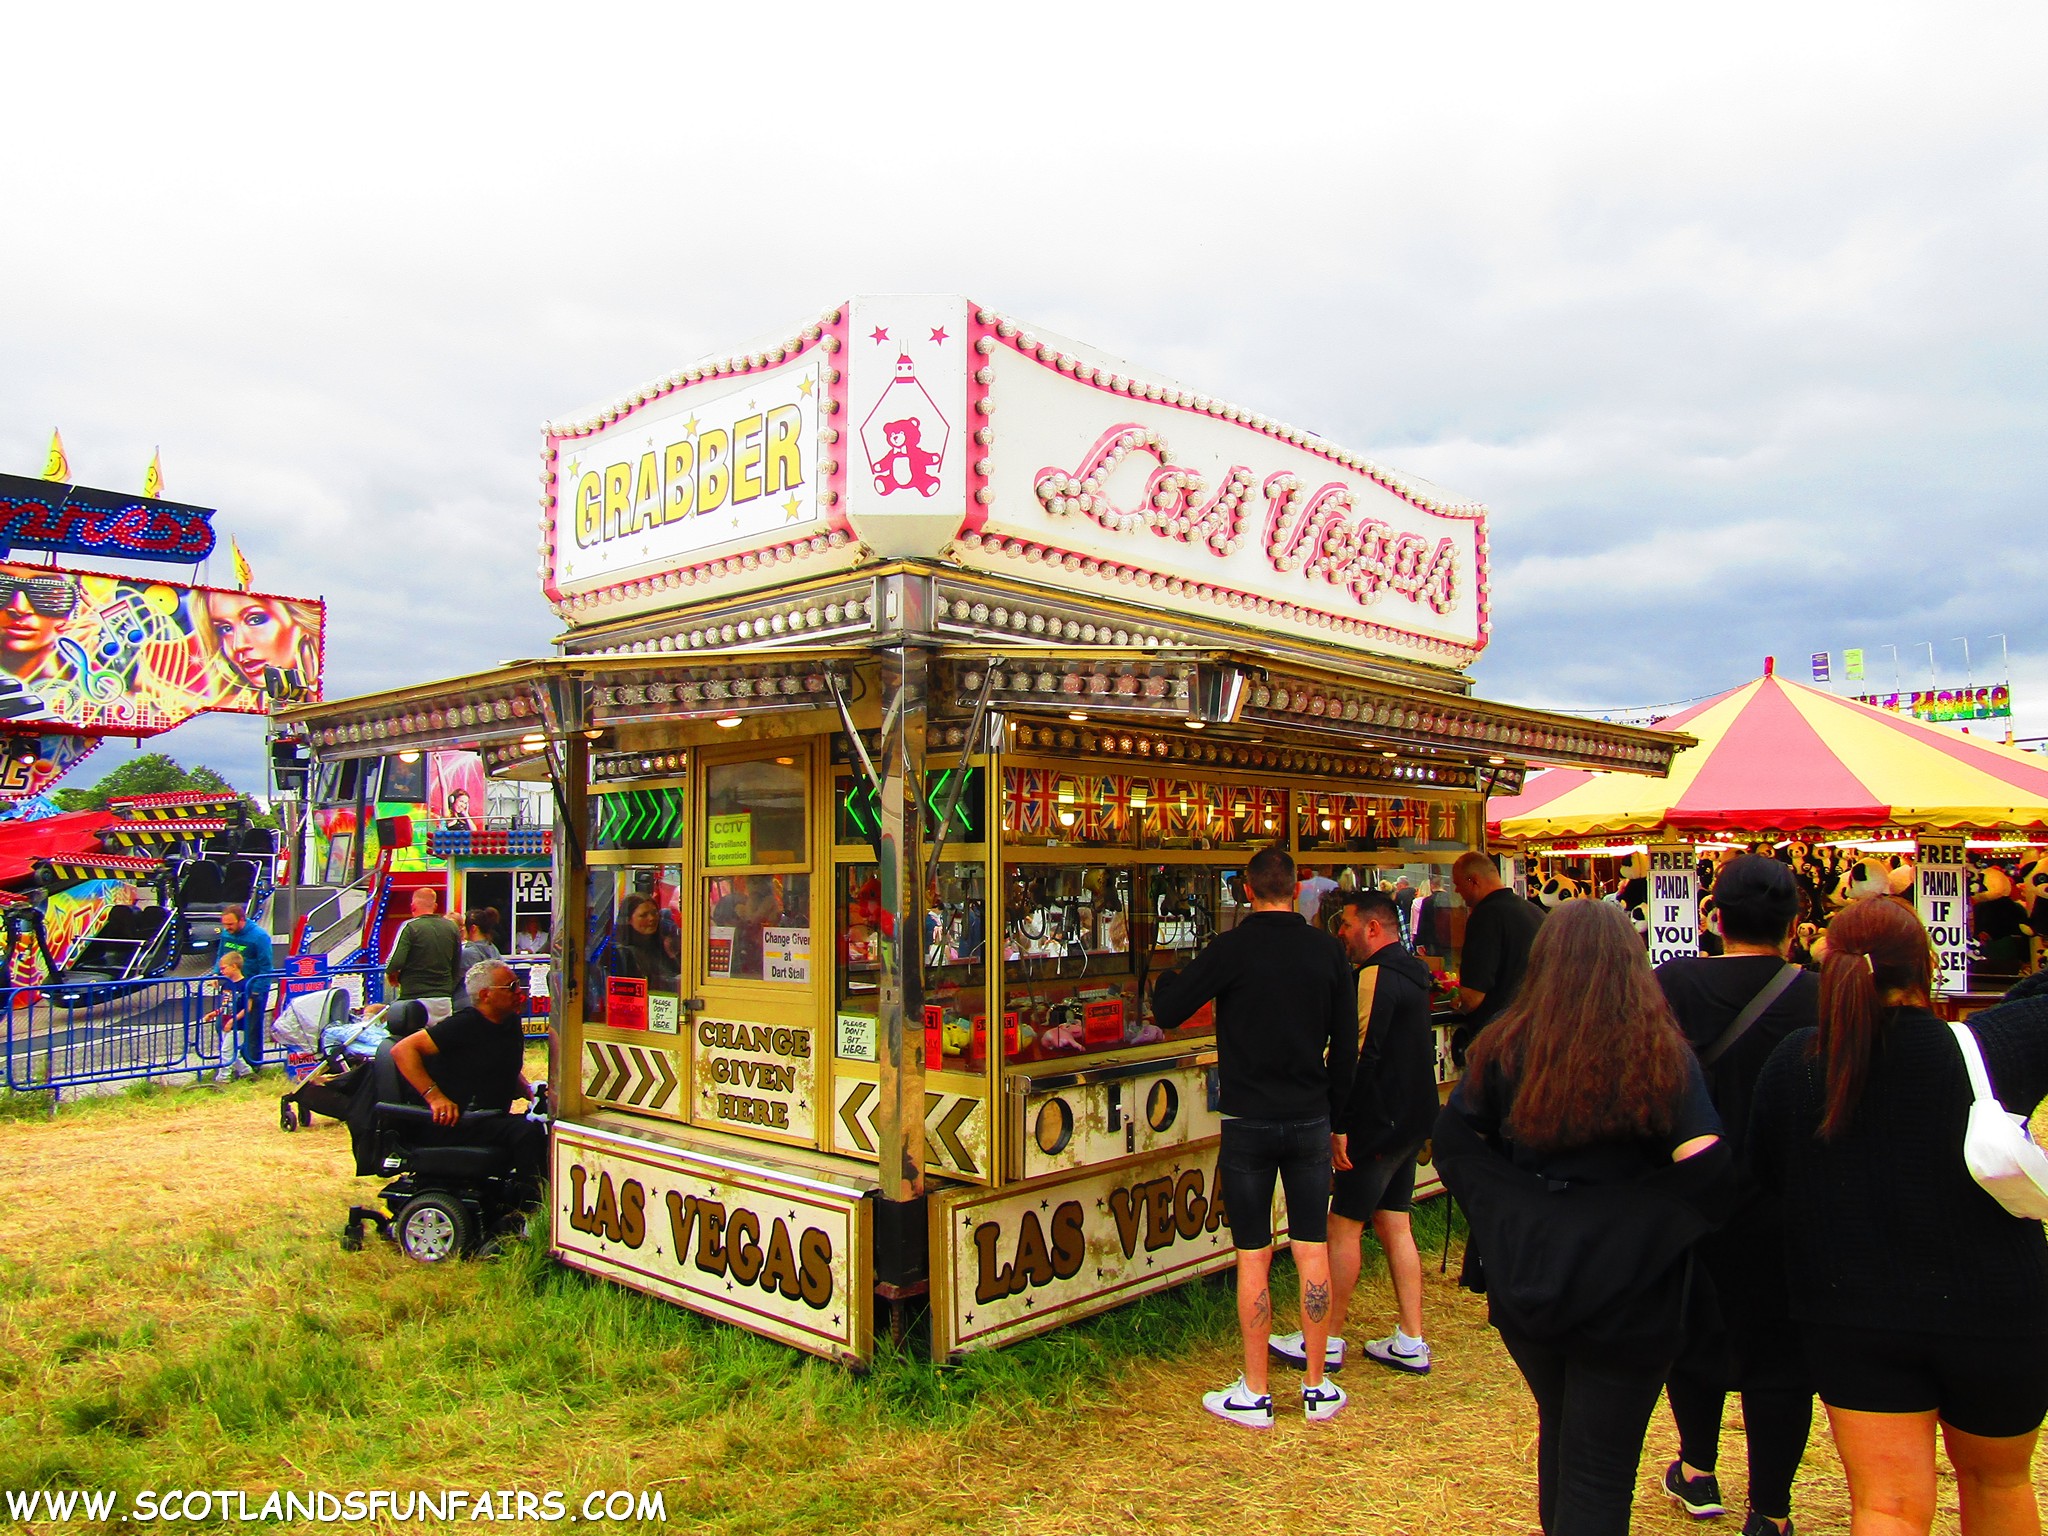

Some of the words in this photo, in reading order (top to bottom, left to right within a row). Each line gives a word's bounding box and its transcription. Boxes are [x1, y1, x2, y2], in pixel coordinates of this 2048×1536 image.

[575, 403, 805, 550] GRABBER
[1033, 422, 1258, 557] Las
[1261, 470, 1462, 614] Vegas
[714, 821, 743, 834] CCTV
[709, 840, 747, 850] Surveillance
[709, 852, 716, 860] in
[717, 852, 747, 862] operation
[1650, 852, 1694, 869] FREE
[1917, 845, 1962, 864] FREE
[1655, 876, 1689, 899] PANDA
[1923, 871, 1958, 896] PANDA
[1664, 906, 1679, 922] IF
[1931, 901, 1950, 922] IF
[764, 931, 790, 946] Change
[1654, 926, 1693, 943] YOU
[1928, 926, 1961, 946] OU
[784, 953, 792, 961] at
[1940, 951, 1966, 971] SE!
[771, 966, 788, 979] Dart
[789, 967, 805, 979] Stall
[289, 983, 305, 992] YOU
[652, 999, 671, 1007] PLEASE
[652, 1021, 670, 1029] HERE
[843, 1020, 867, 1028] PLEASE
[698, 1020, 811, 1058] CHANGE
[847, 1036, 860, 1044] SIT
[843, 1045, 867, 1055] HERE
[711, 1058, 795, 1093] GIVEN
[717, 1093, 789, 1130] HERE
[570, 1164, 645, 1249] LAS
[665, 1189, 834, 1310] VEGAS
[973, 1200, 1085, 1305] LAS
